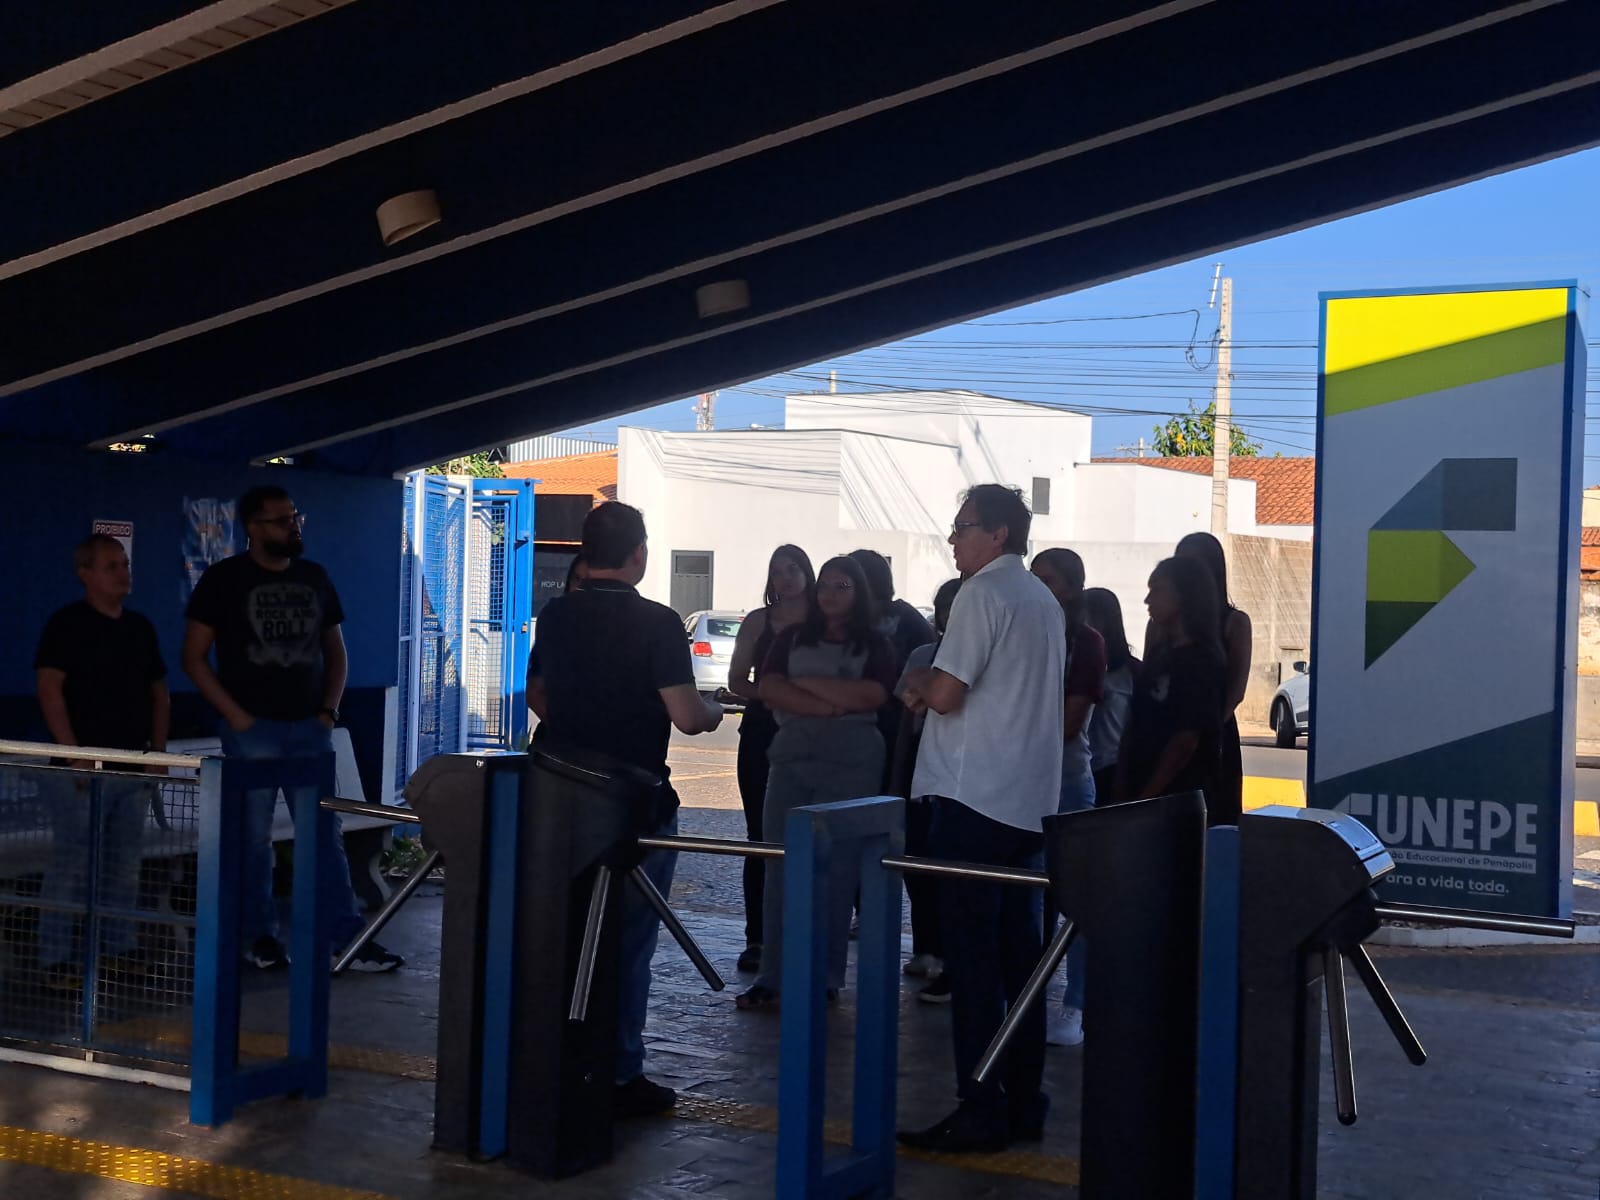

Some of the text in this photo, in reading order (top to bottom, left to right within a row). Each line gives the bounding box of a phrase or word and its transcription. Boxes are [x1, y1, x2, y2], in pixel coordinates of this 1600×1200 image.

[255, 609, 288, 620] ROCK
[263, 620, 309, 641] ROLL
[1406, 852, 1465, 864] Educacional
[1468, 857, 1480, 866] de
[1386, 874, 1510, 893] ara a vida toda.
